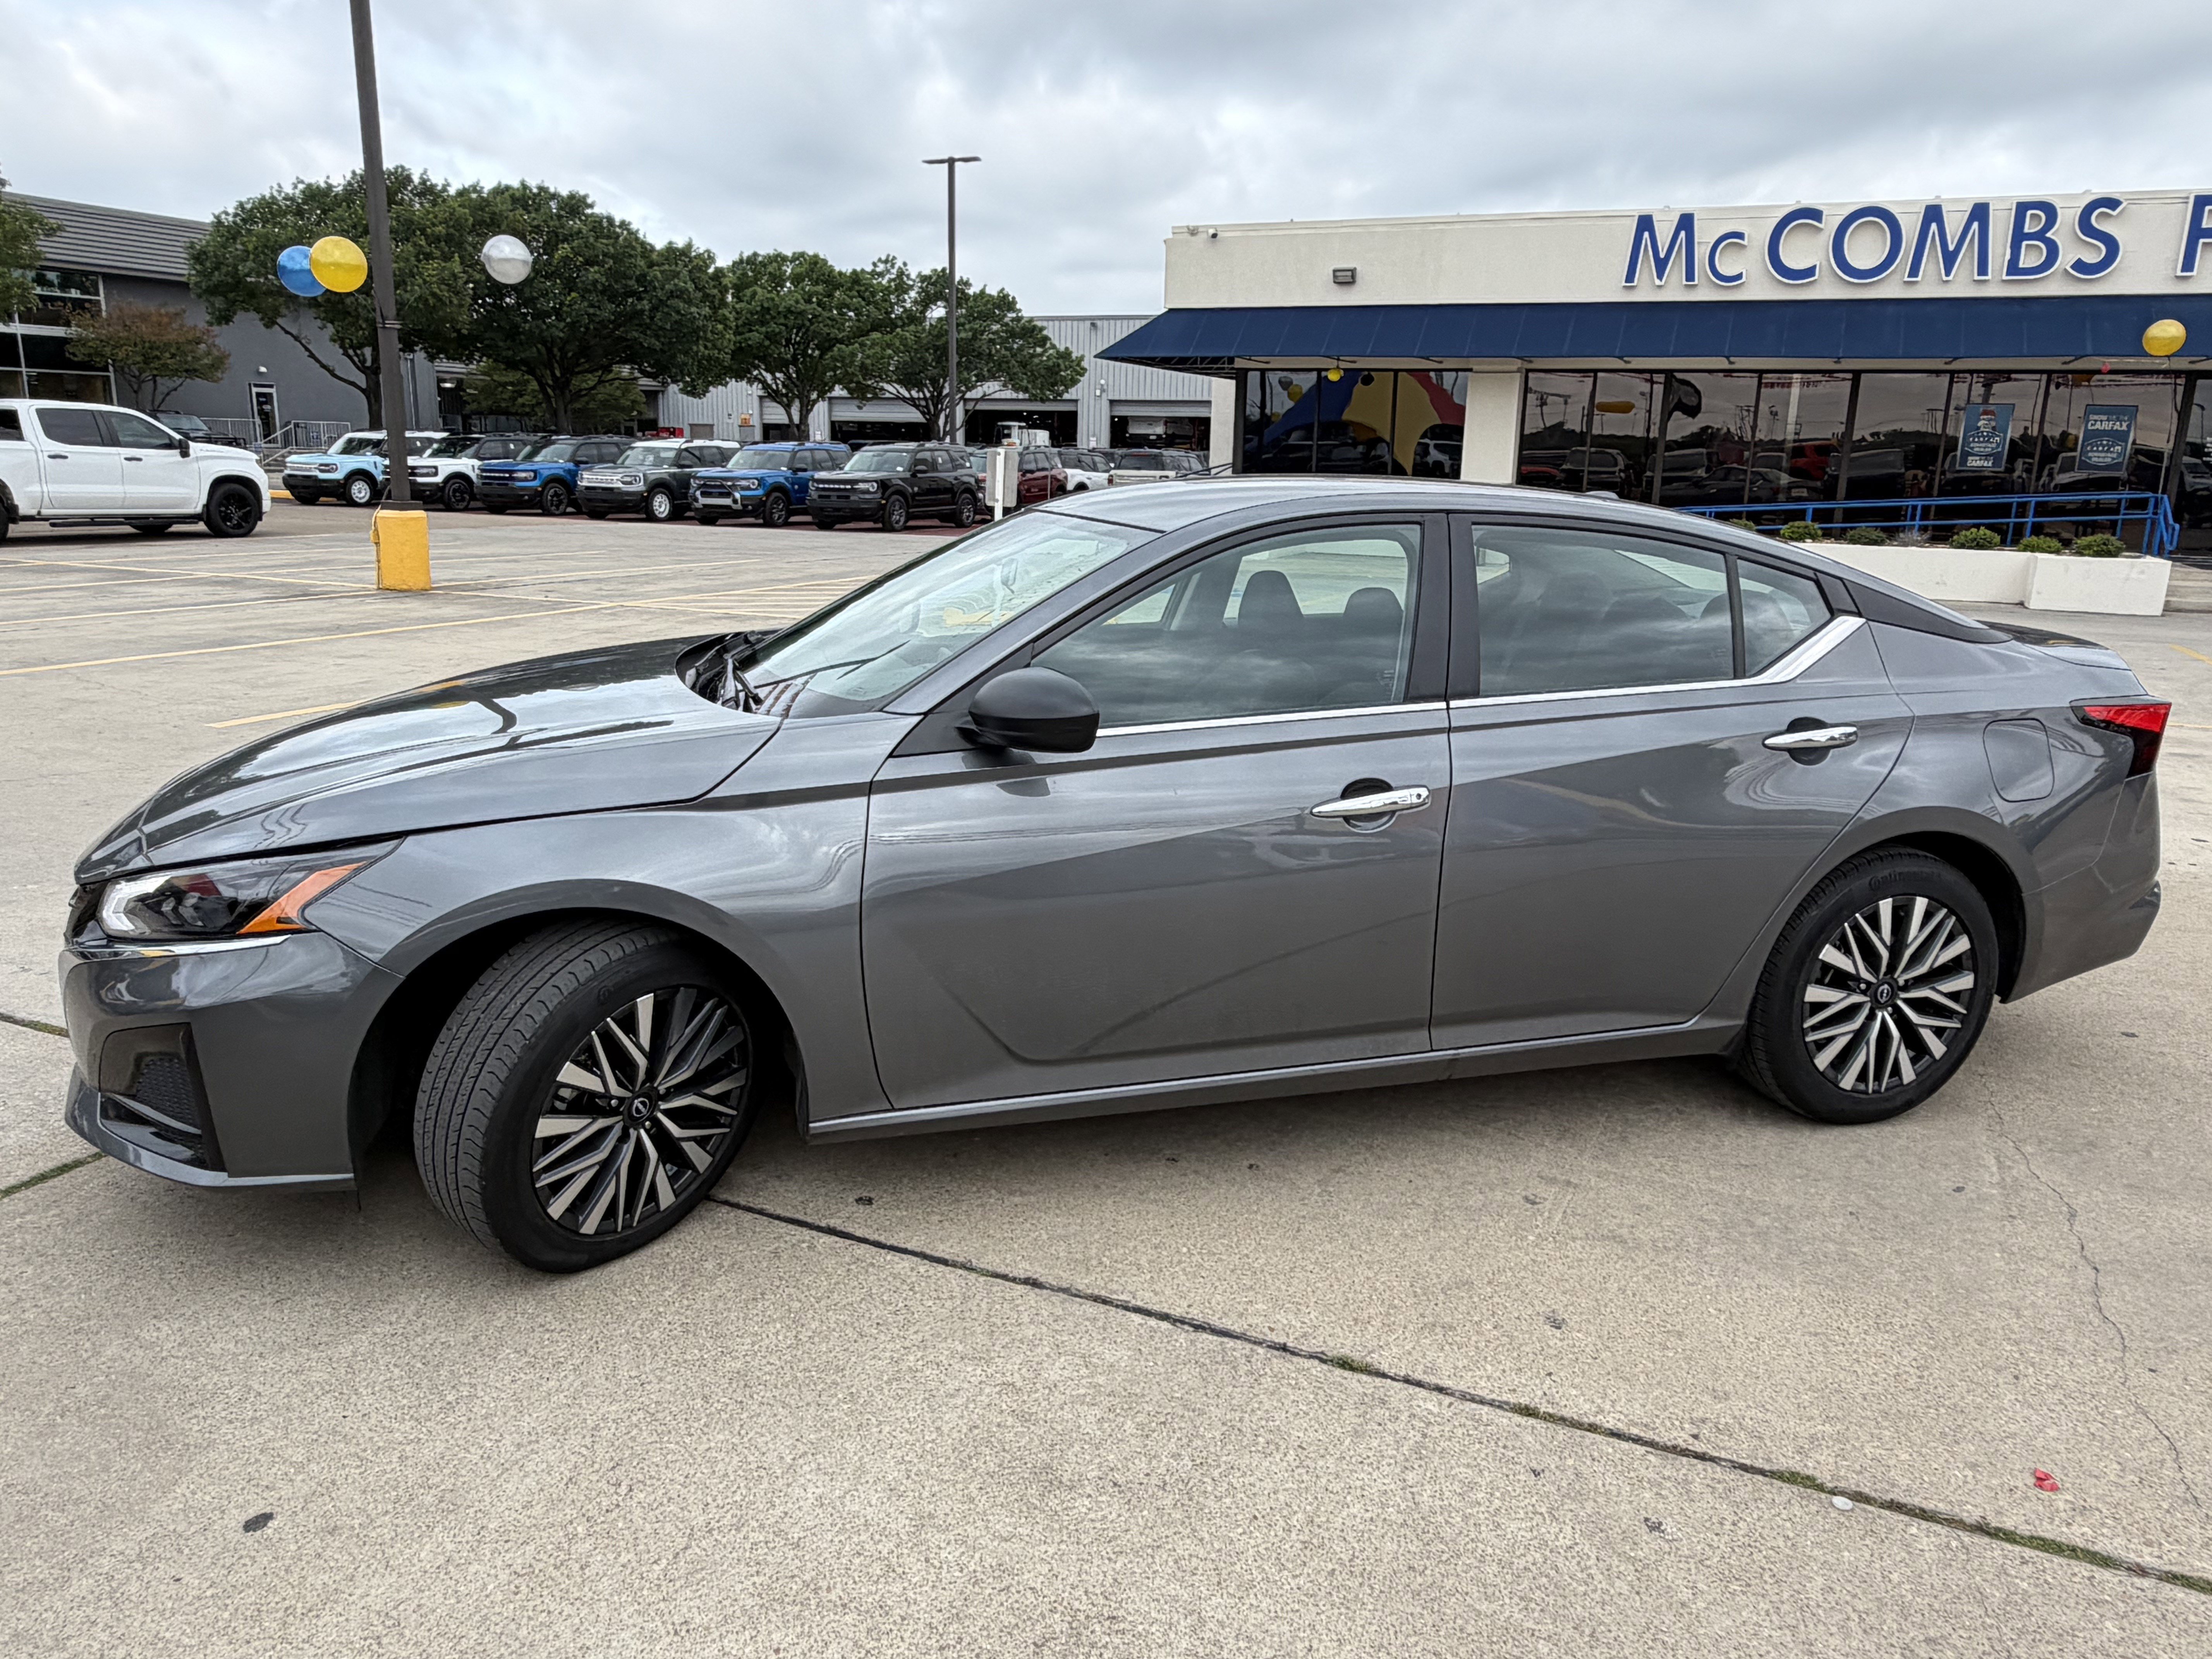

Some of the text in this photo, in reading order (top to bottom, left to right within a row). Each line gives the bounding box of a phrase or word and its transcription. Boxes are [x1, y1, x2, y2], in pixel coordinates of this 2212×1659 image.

[1623, 196, 2128, 286] McCOMBS
[2088, 421, 2130, 430] CARFAX
[1869, 870, 1941, 891] Contin
